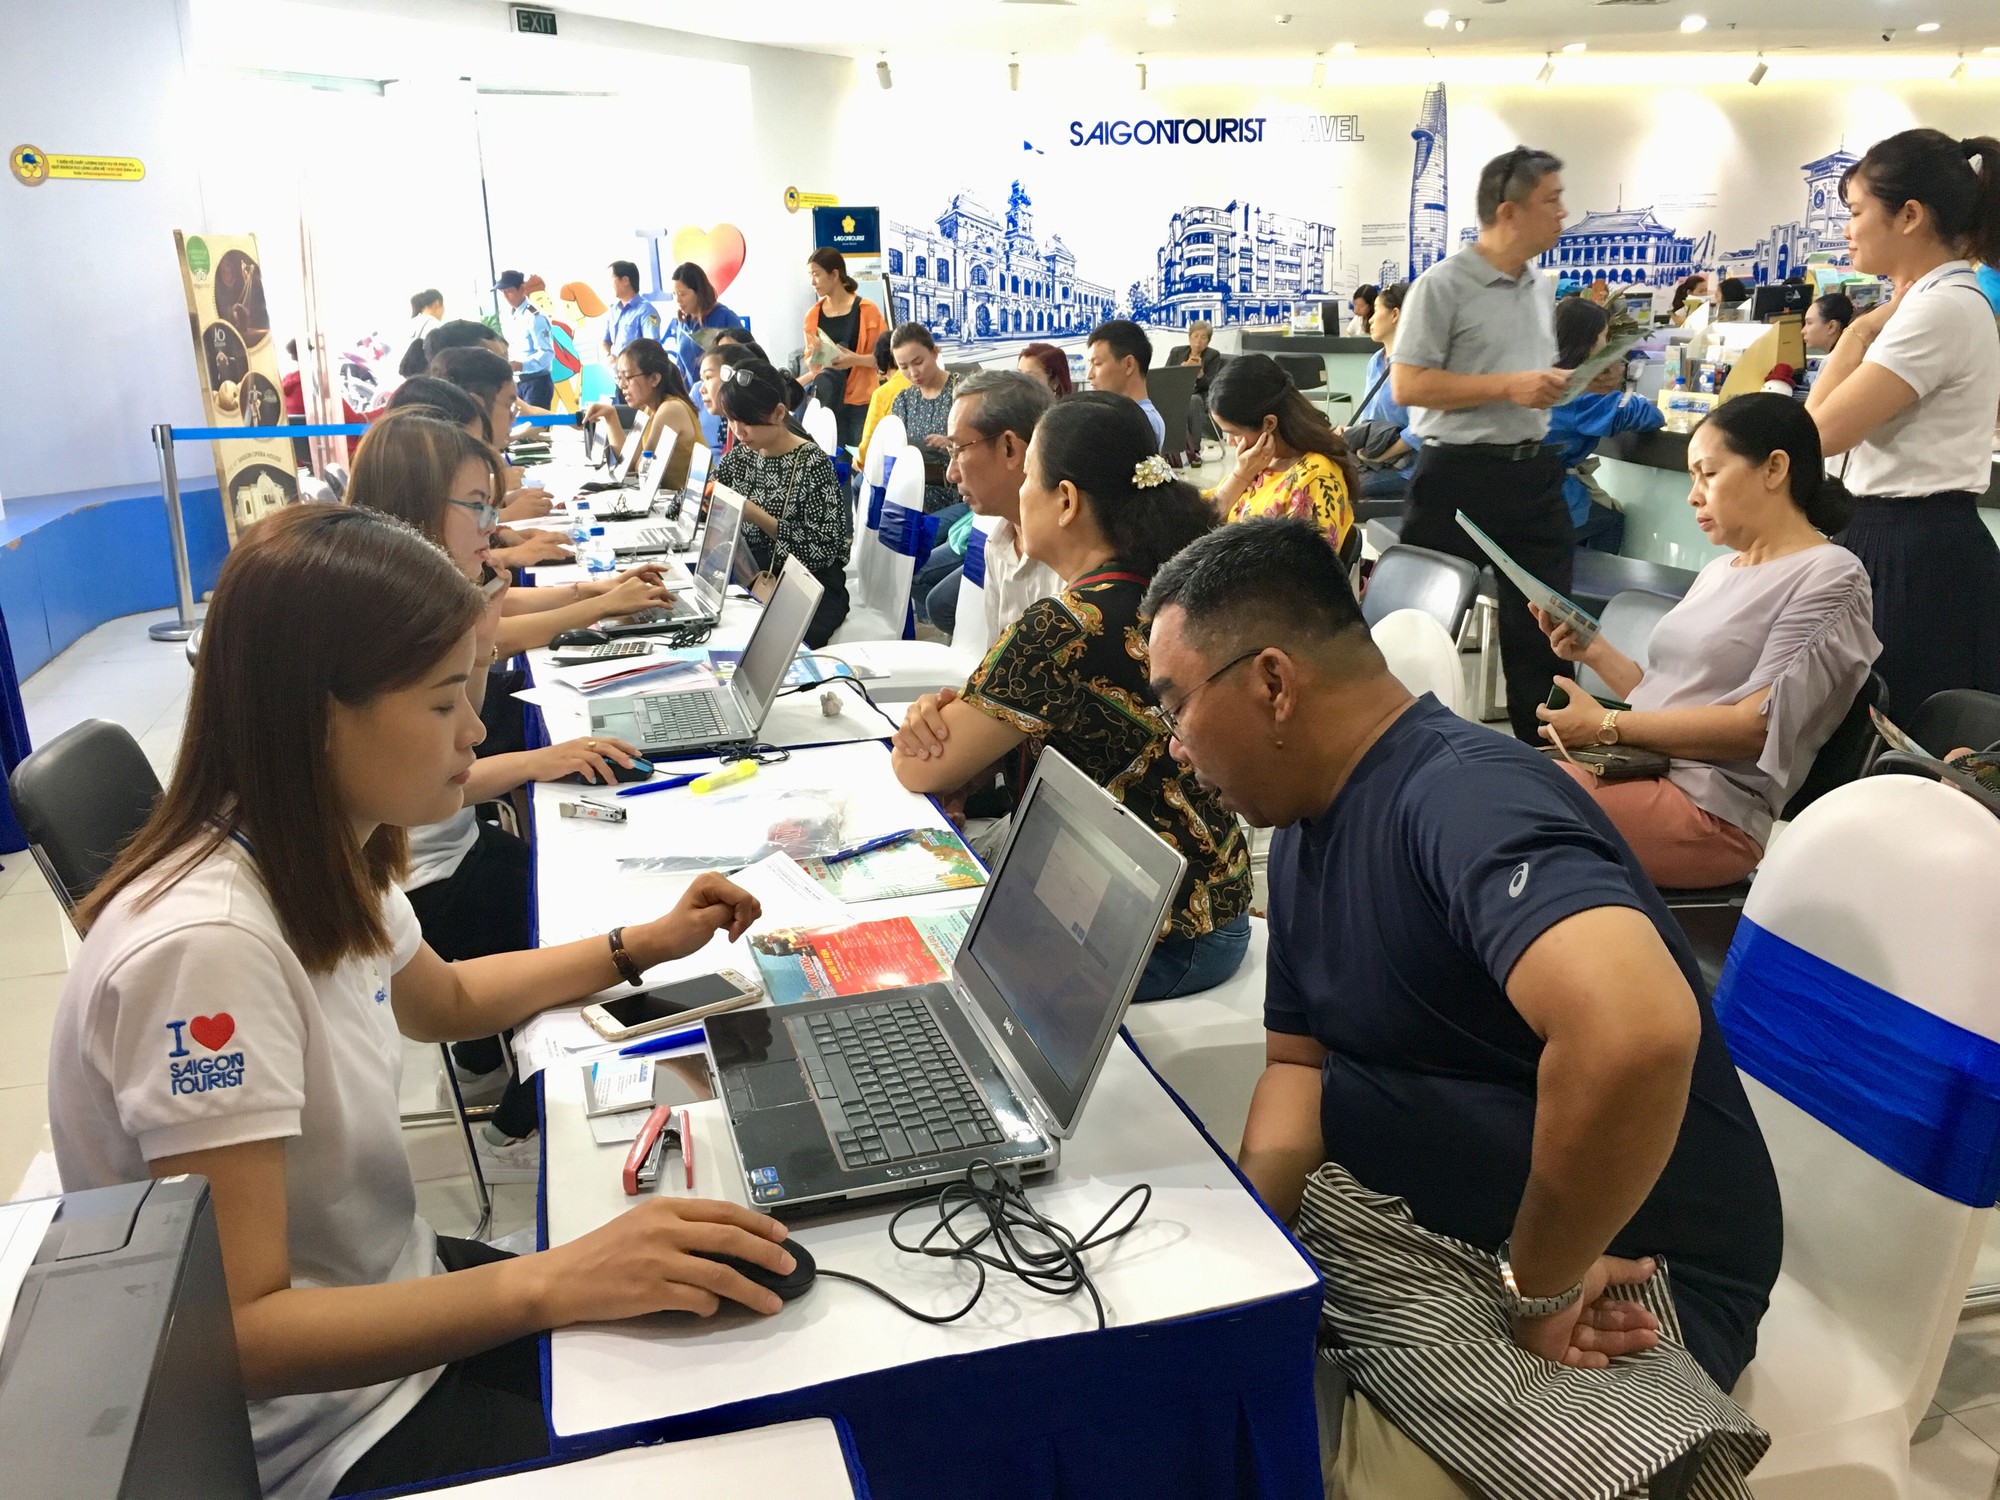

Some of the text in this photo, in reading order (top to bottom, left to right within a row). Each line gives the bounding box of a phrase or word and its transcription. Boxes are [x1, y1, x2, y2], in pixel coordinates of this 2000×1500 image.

[519, 11, 553, 33] EXIT
[1069, 115, 1365, 147] SAIGONTOURIST AVEL
[635, 228, 673, 301] I
[166, 1020, 190, 1058] I
[170, 1052, 245, 1079] SAIGON
[171, 1067, 245, 1096] TOURIST
